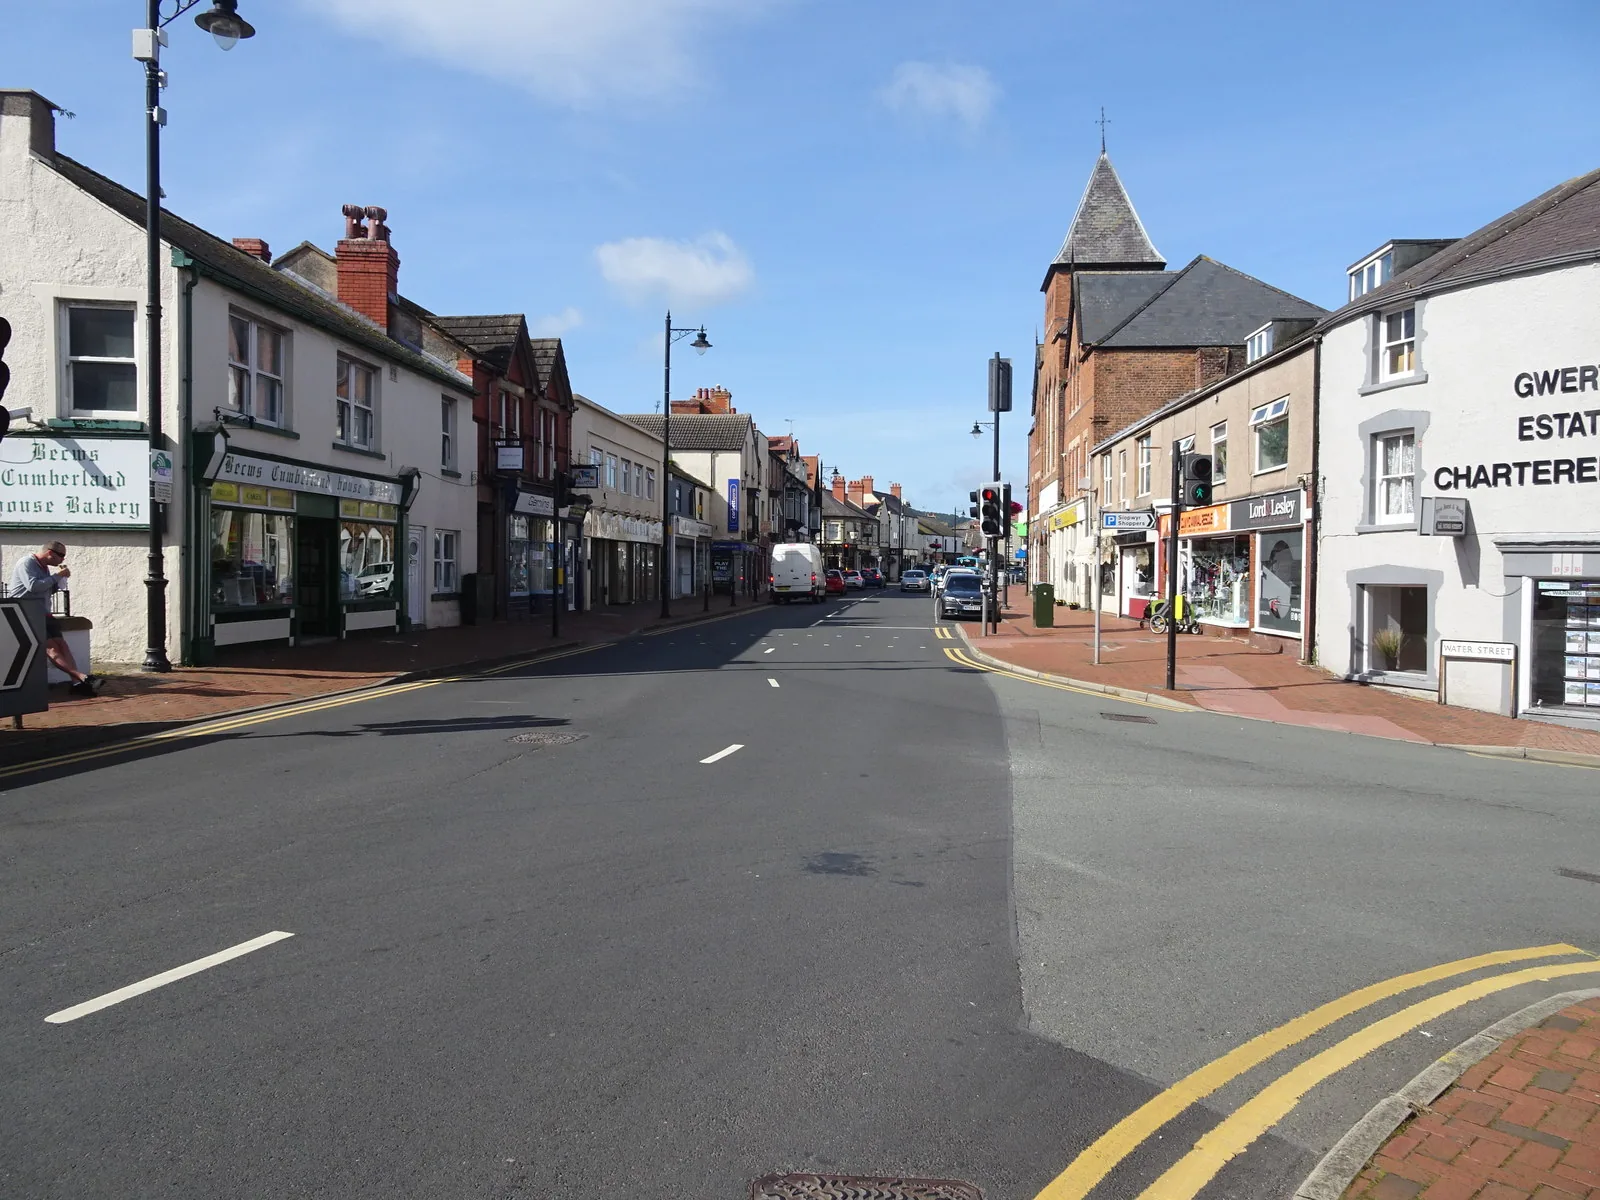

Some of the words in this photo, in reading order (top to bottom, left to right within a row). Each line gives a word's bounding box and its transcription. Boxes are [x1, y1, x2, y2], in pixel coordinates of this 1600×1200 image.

[1514, 365, 1600, 398] GWER
[1518, 410, 1600, 441] ESTAT
[32, 442, 99, 461] Becws
[1, 468, 126, 487] Cumberland
[225, 455, 263, 478] Becws
[271, 465, 330, 489] Cumberland
[337, 476, 362, 493] house
[1434, 457, 1600, 491] CHARTERE
[0, 499, 54, 515] ouse
[66, 495, 140, 519] Bakery
[1249, 499, 1266, 519] Lord
[1271, 496, 1295, 519] Lesley
[1444, 644, 1473, 653] WATER
[1477, 646, 1512, 655] STREET
